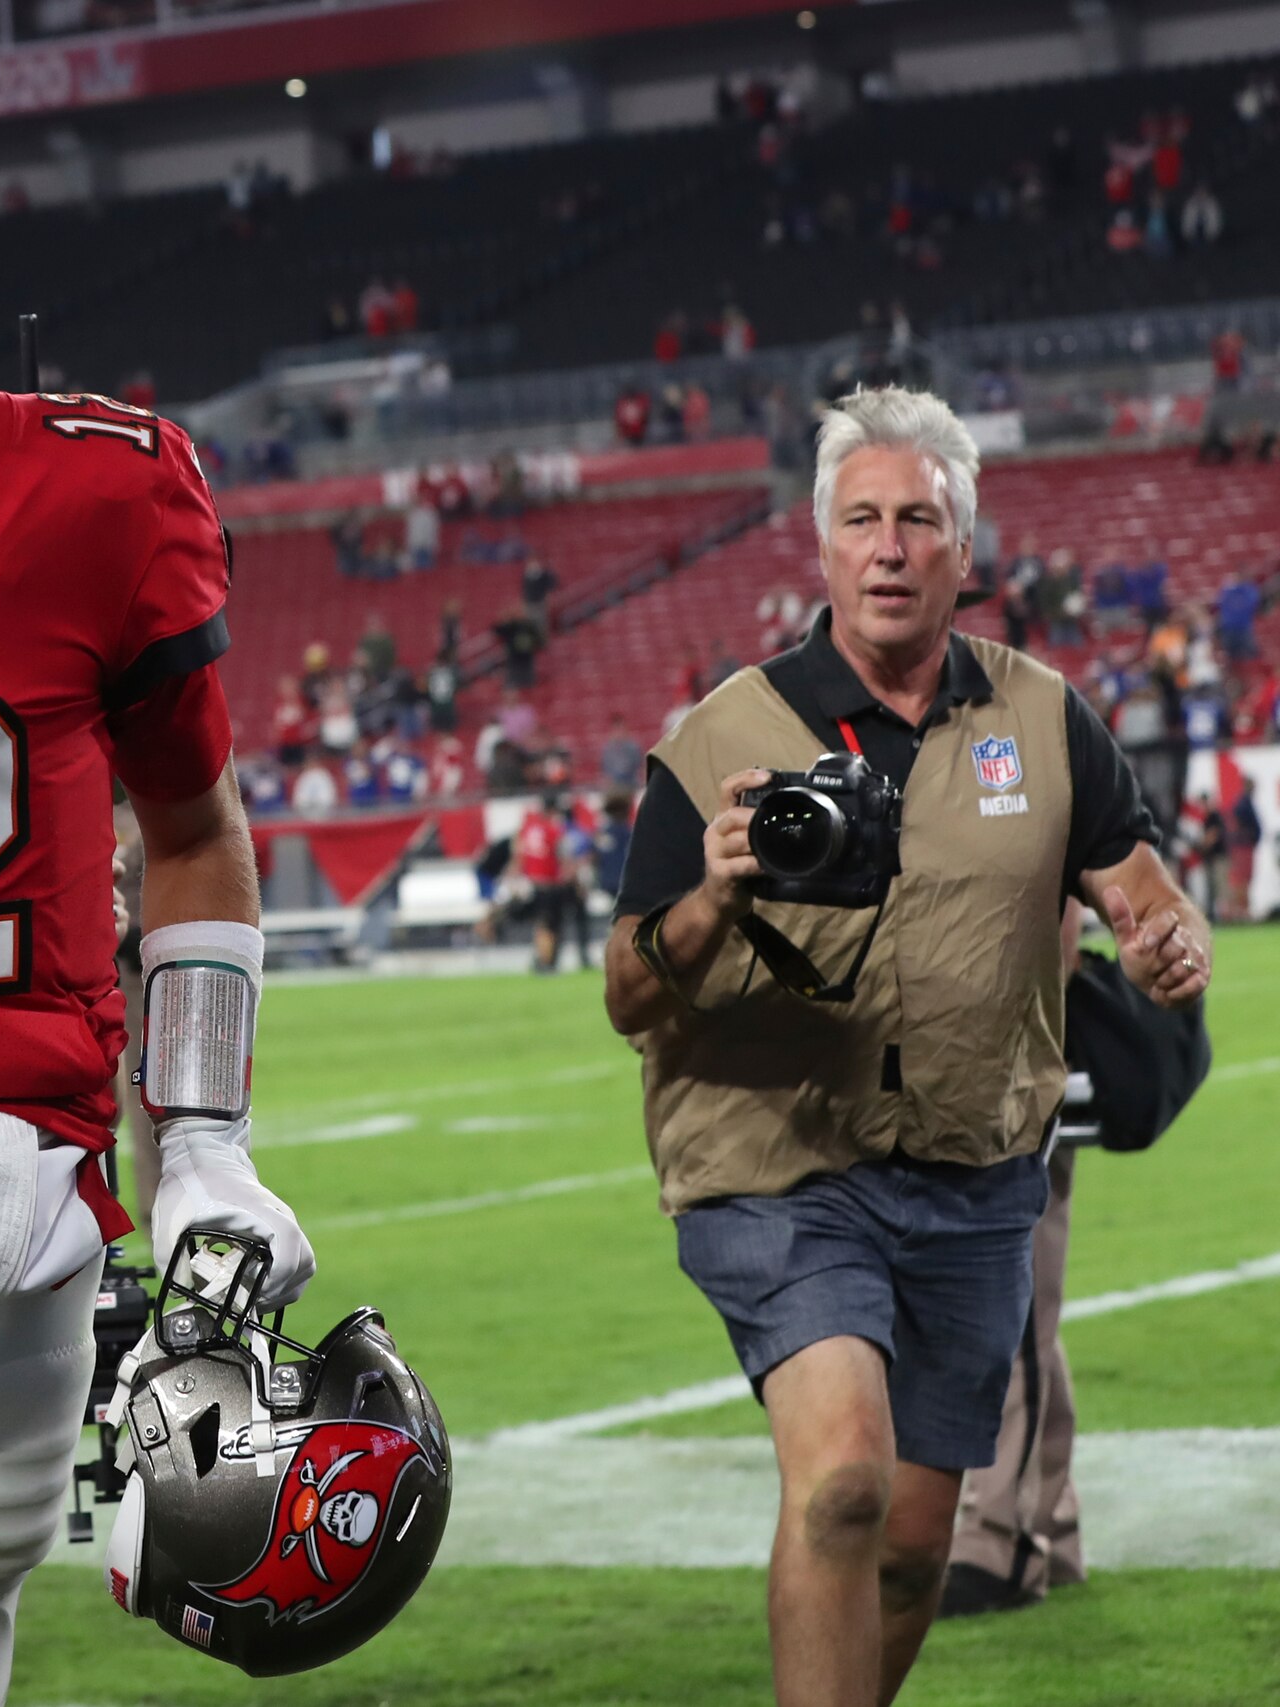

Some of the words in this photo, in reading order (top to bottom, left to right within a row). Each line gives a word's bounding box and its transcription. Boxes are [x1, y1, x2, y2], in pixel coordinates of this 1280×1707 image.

[813, 774, 843, 786] Nikon
[980, 758, 1016, 782] NFL
[978, 793, 1030, 818] MEDIA
